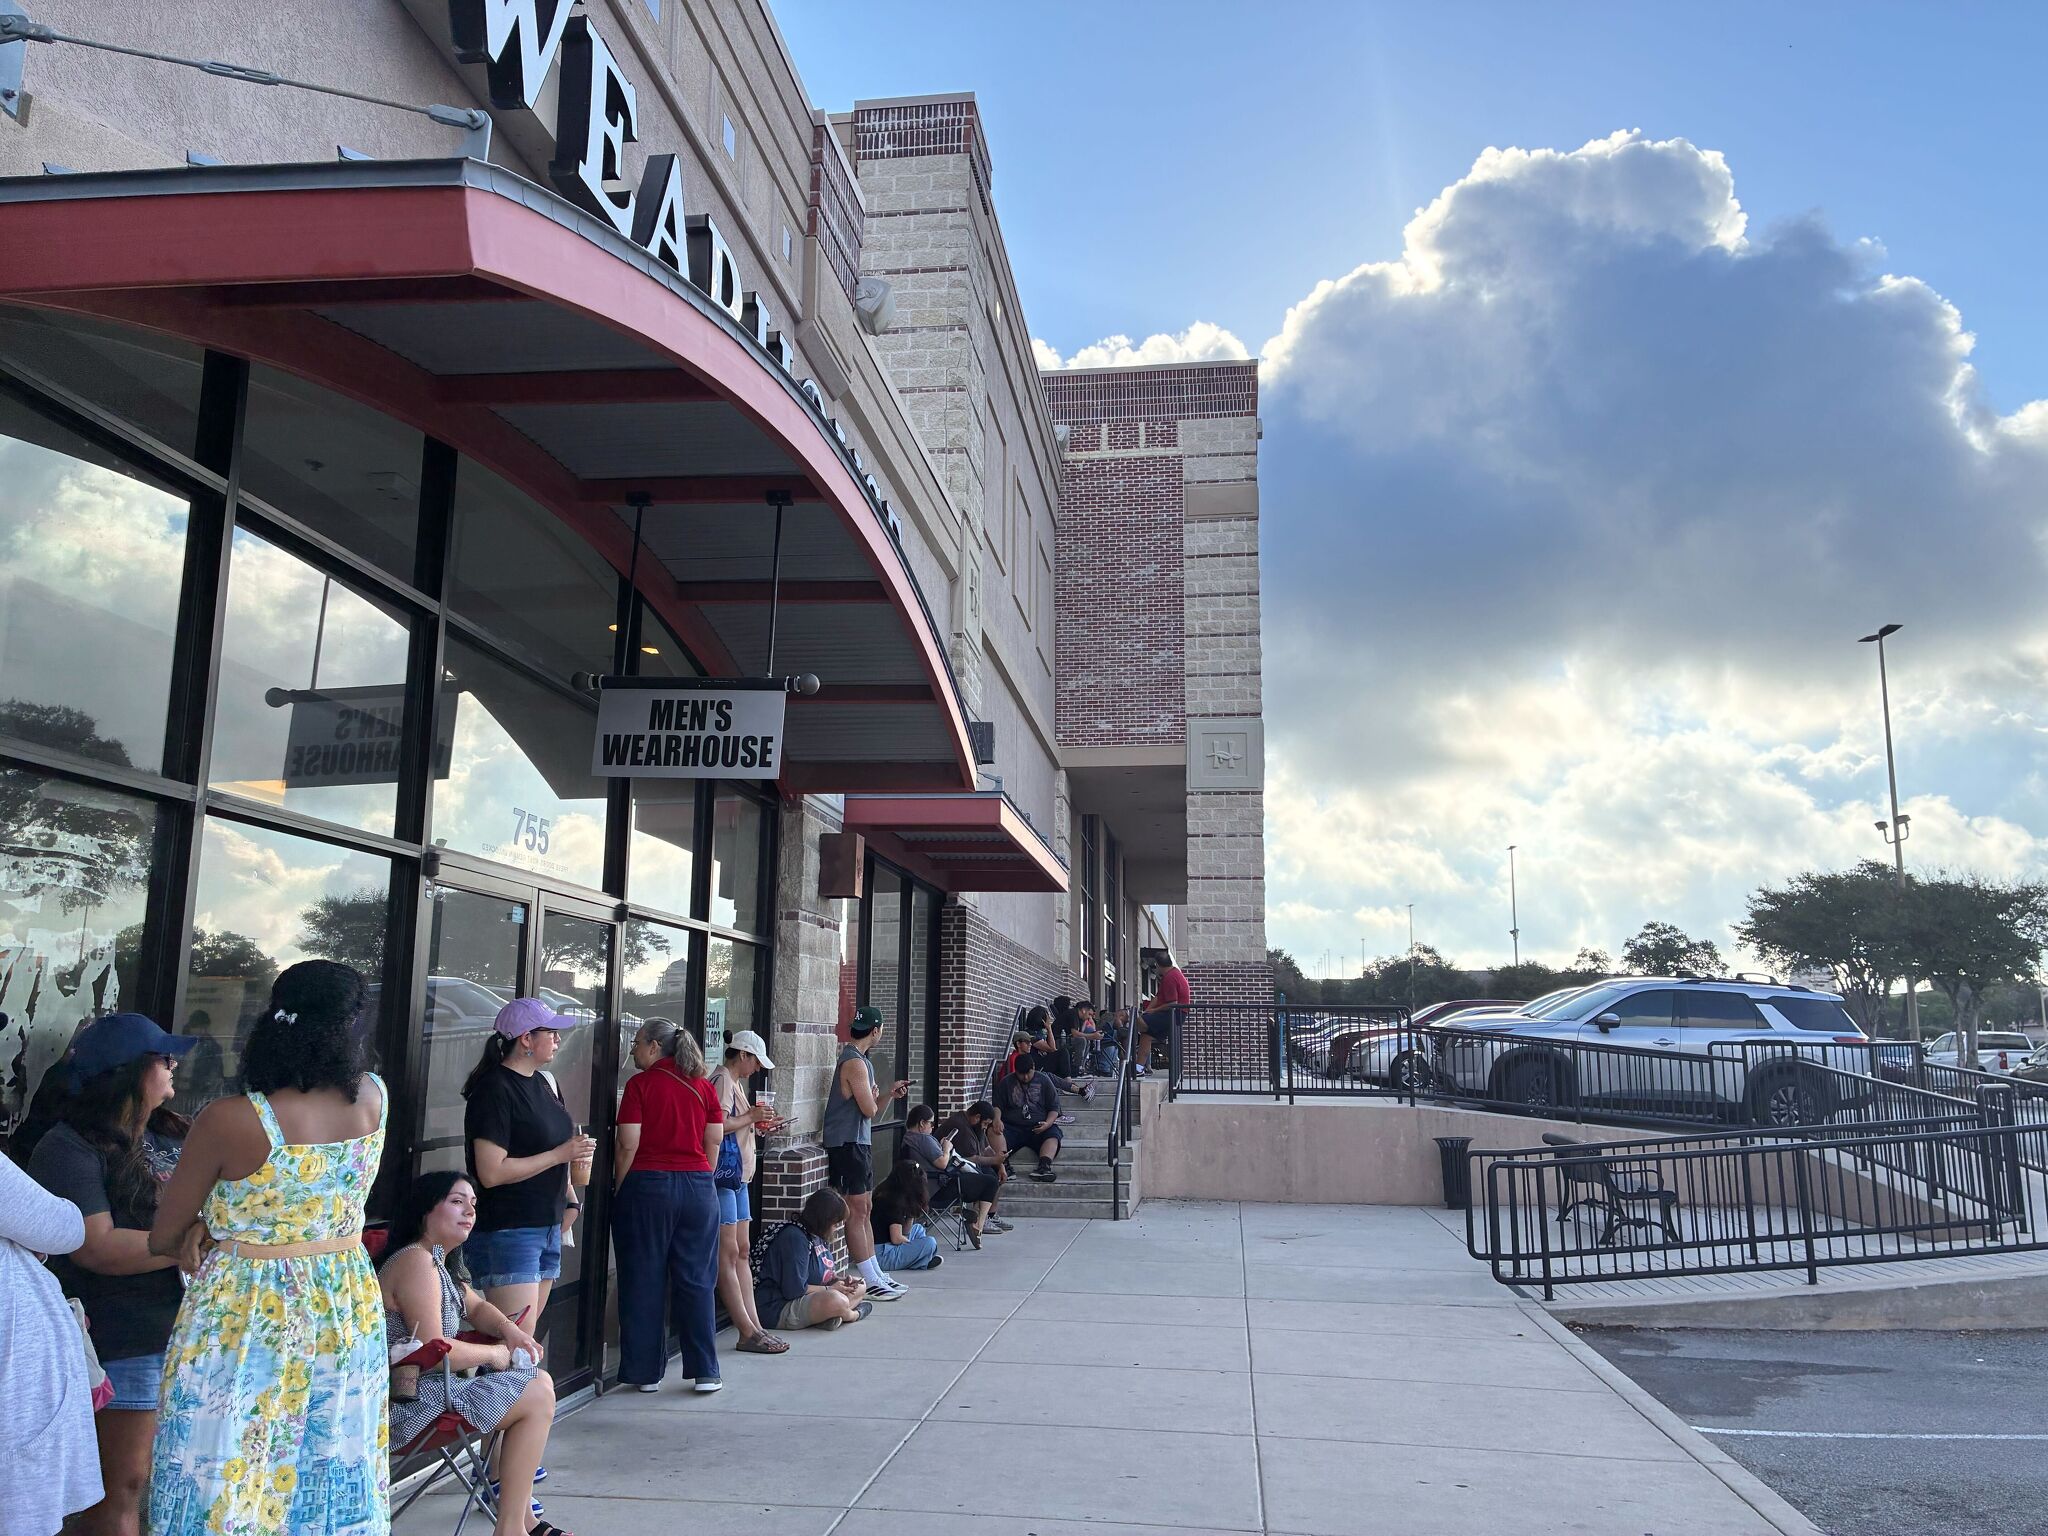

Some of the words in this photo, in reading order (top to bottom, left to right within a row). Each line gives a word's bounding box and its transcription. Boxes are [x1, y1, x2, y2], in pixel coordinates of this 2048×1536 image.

[649, 700, 733, 732] MEN'S
[602, 734, 774, 768] WEARHOUSE
[513, 807, 550, 855] 755
